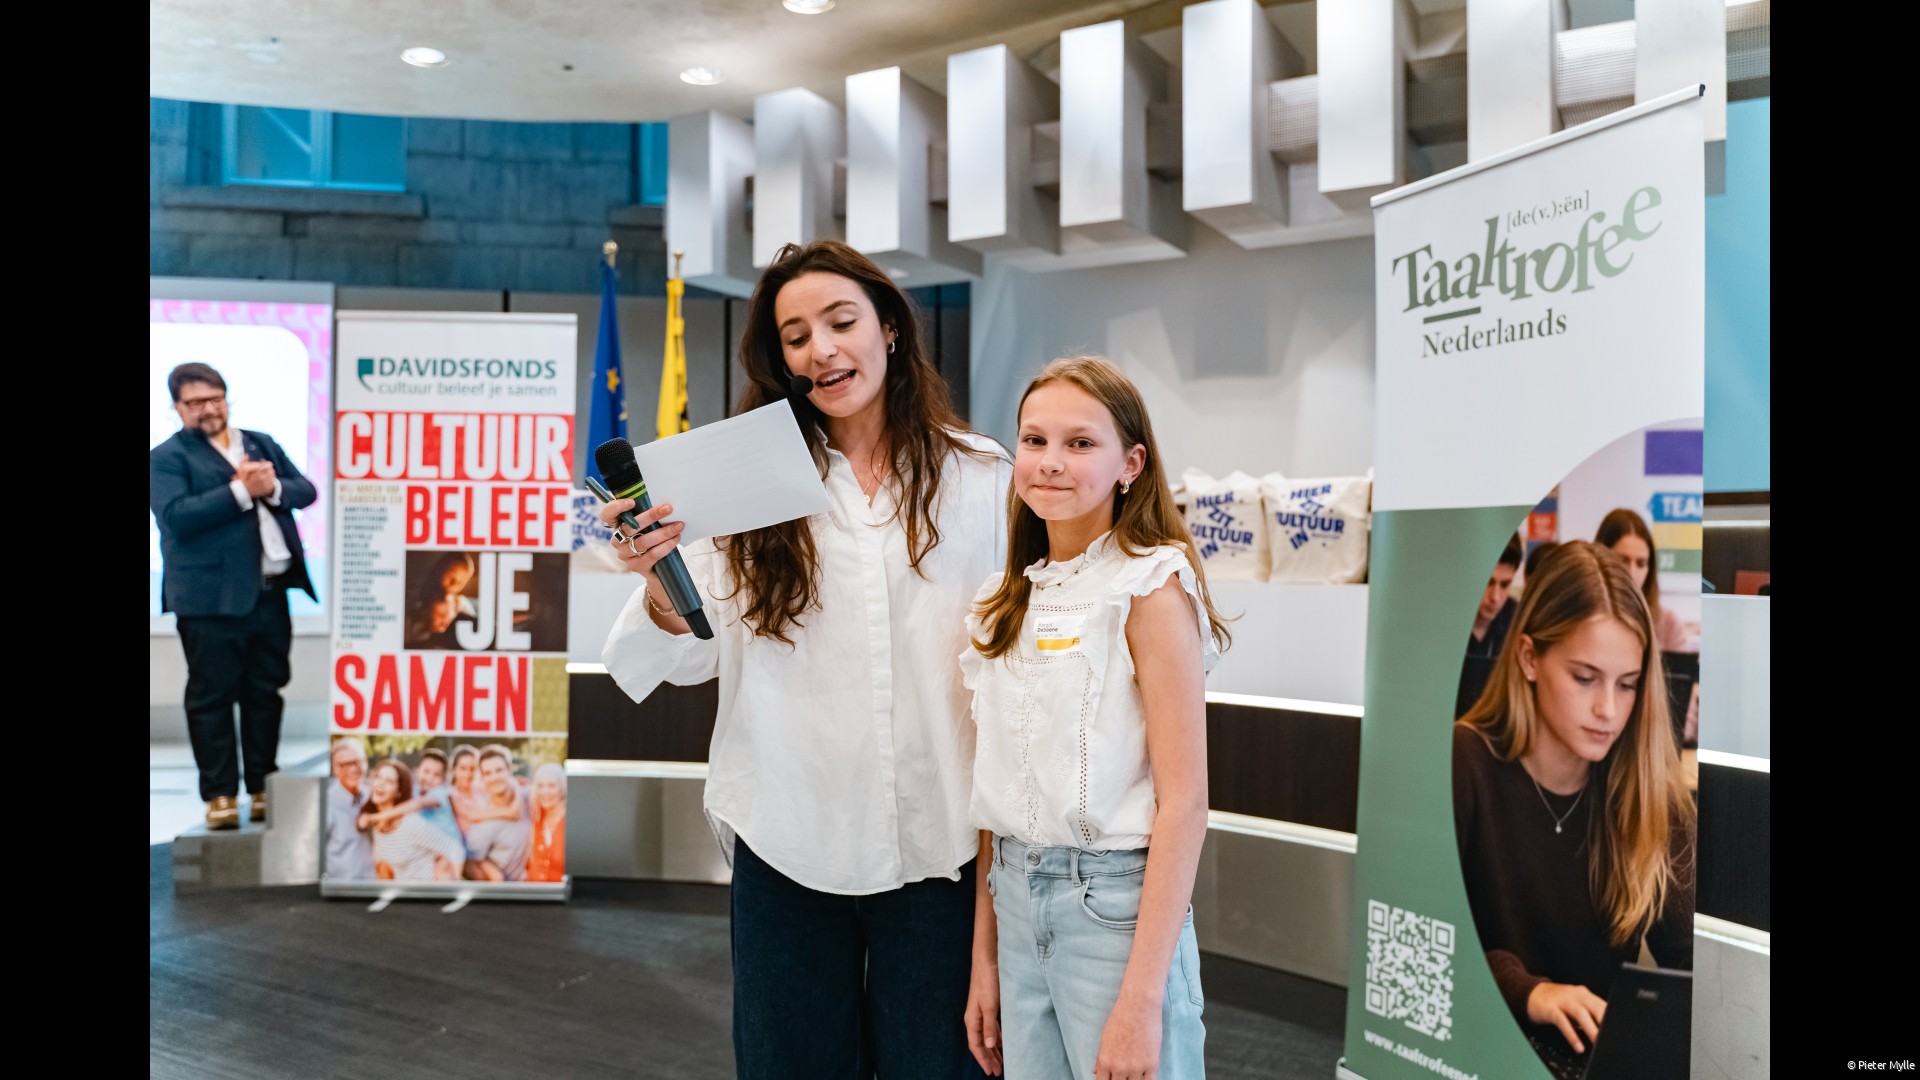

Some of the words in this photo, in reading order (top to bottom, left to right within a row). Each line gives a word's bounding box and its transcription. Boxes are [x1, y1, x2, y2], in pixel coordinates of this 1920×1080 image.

[1393, 186, 1663, 312] Taaltrofee
[1421, 308, 1568, 358] Nederlands
[379, 358, 557, 379] DAVIDSFONDS
[378, 382, 433, 395] cultuur
[437, 382, 484, 396] beleef
[489, 384, 503, 399] je
[508, 387, 558, 397] samen
[337, 412, 571, 480] CULTUUR
[1196, 491, 1234, 509] HIER
[1290, 484, 1332, 500] HIER
[405, 486, 569, 546] BELEEF
[1208, 507, 1235, 527] ZIT
[1662, 495, 1703, 519] TEA
[1275, 511, 1345, 535] ULTUUR
[1200, 543, 1219, 559] IN
[1290, 532, 1309, 550] IN
[455, 552, 534, 651] JE
[333, 654, 528, 732] SAMEN
